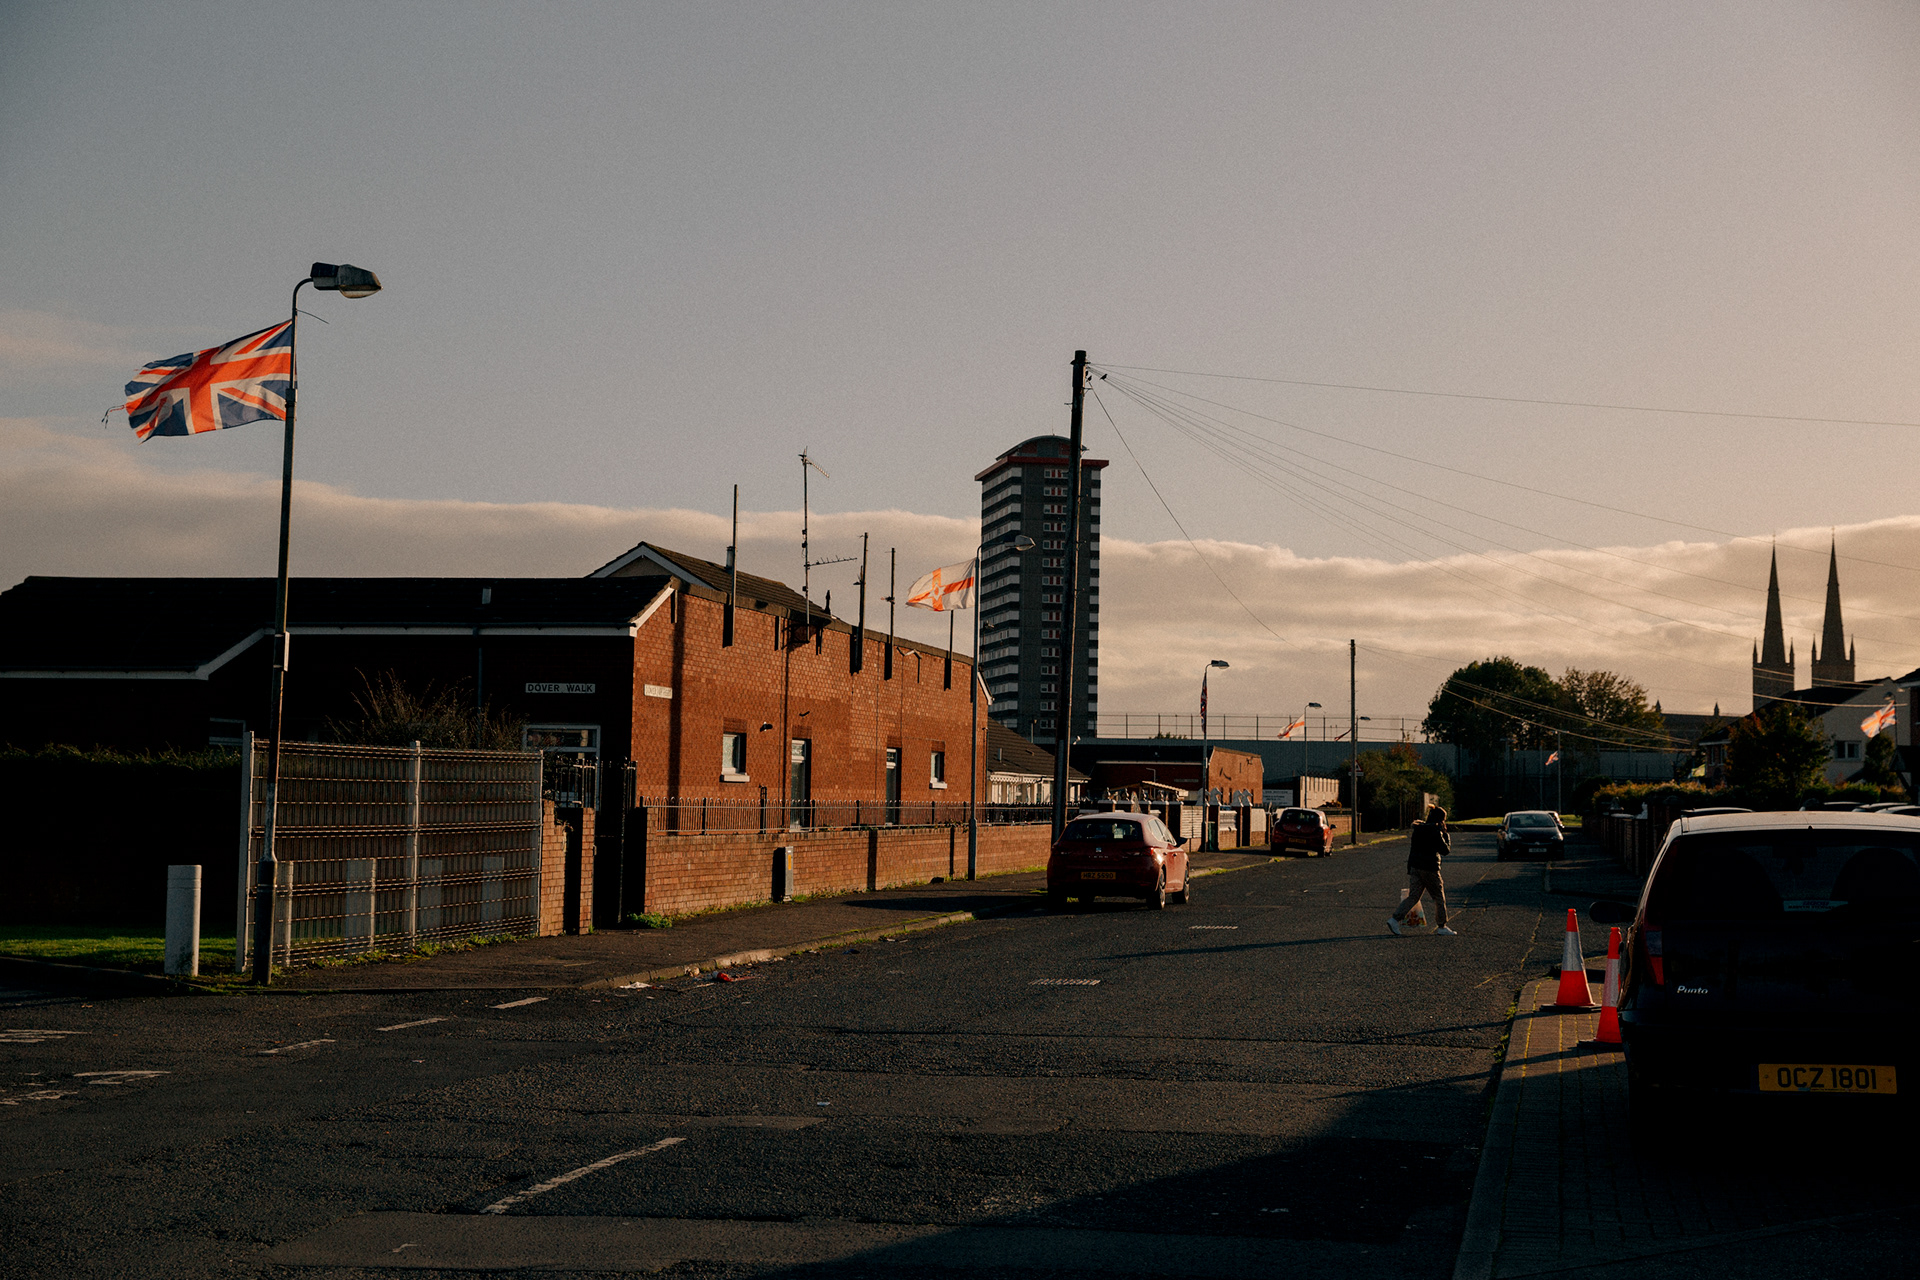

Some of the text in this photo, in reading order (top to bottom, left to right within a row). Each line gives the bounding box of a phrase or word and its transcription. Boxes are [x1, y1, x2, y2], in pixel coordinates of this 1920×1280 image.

[528, 684, 593, 692] DOVER WALK
[1676, 984, 1709, 995] Punto
[1777, 1067, 1877, 1090] OCZ 1801
